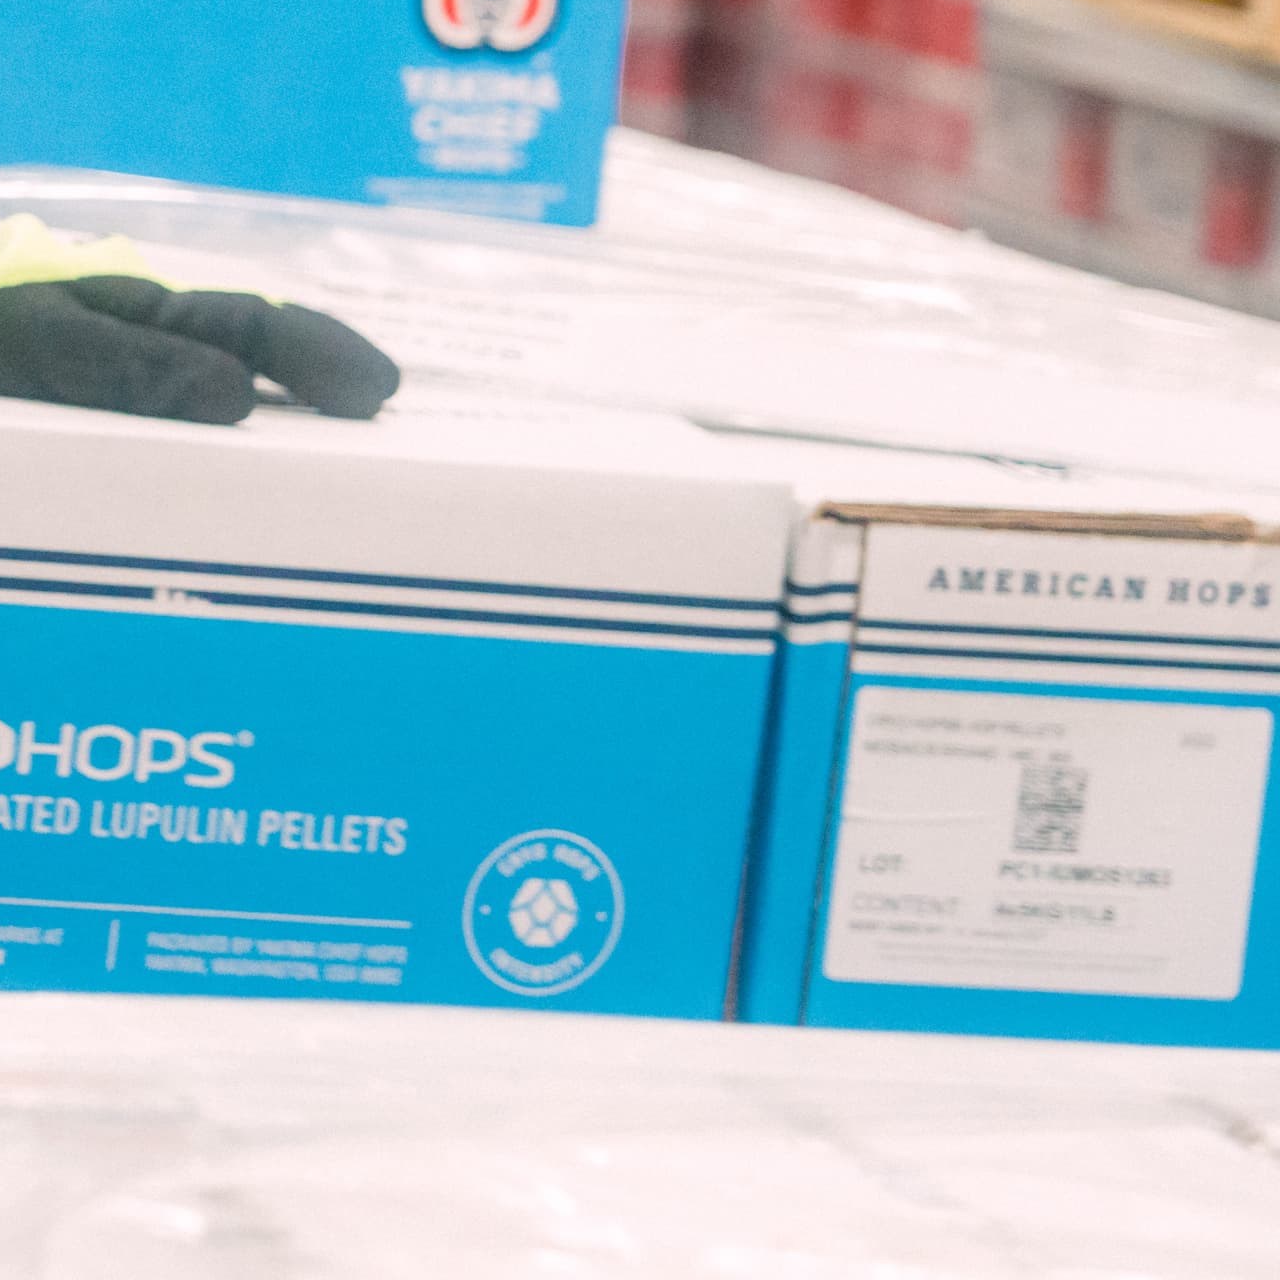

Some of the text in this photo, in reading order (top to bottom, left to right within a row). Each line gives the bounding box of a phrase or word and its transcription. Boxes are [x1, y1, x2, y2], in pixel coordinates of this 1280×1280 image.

[926, 565, 1274, 609] AMERICAN HOPS
[90, 800, 246, 845] LUPULIN
[256, 809, 409, 856] PELLETS
